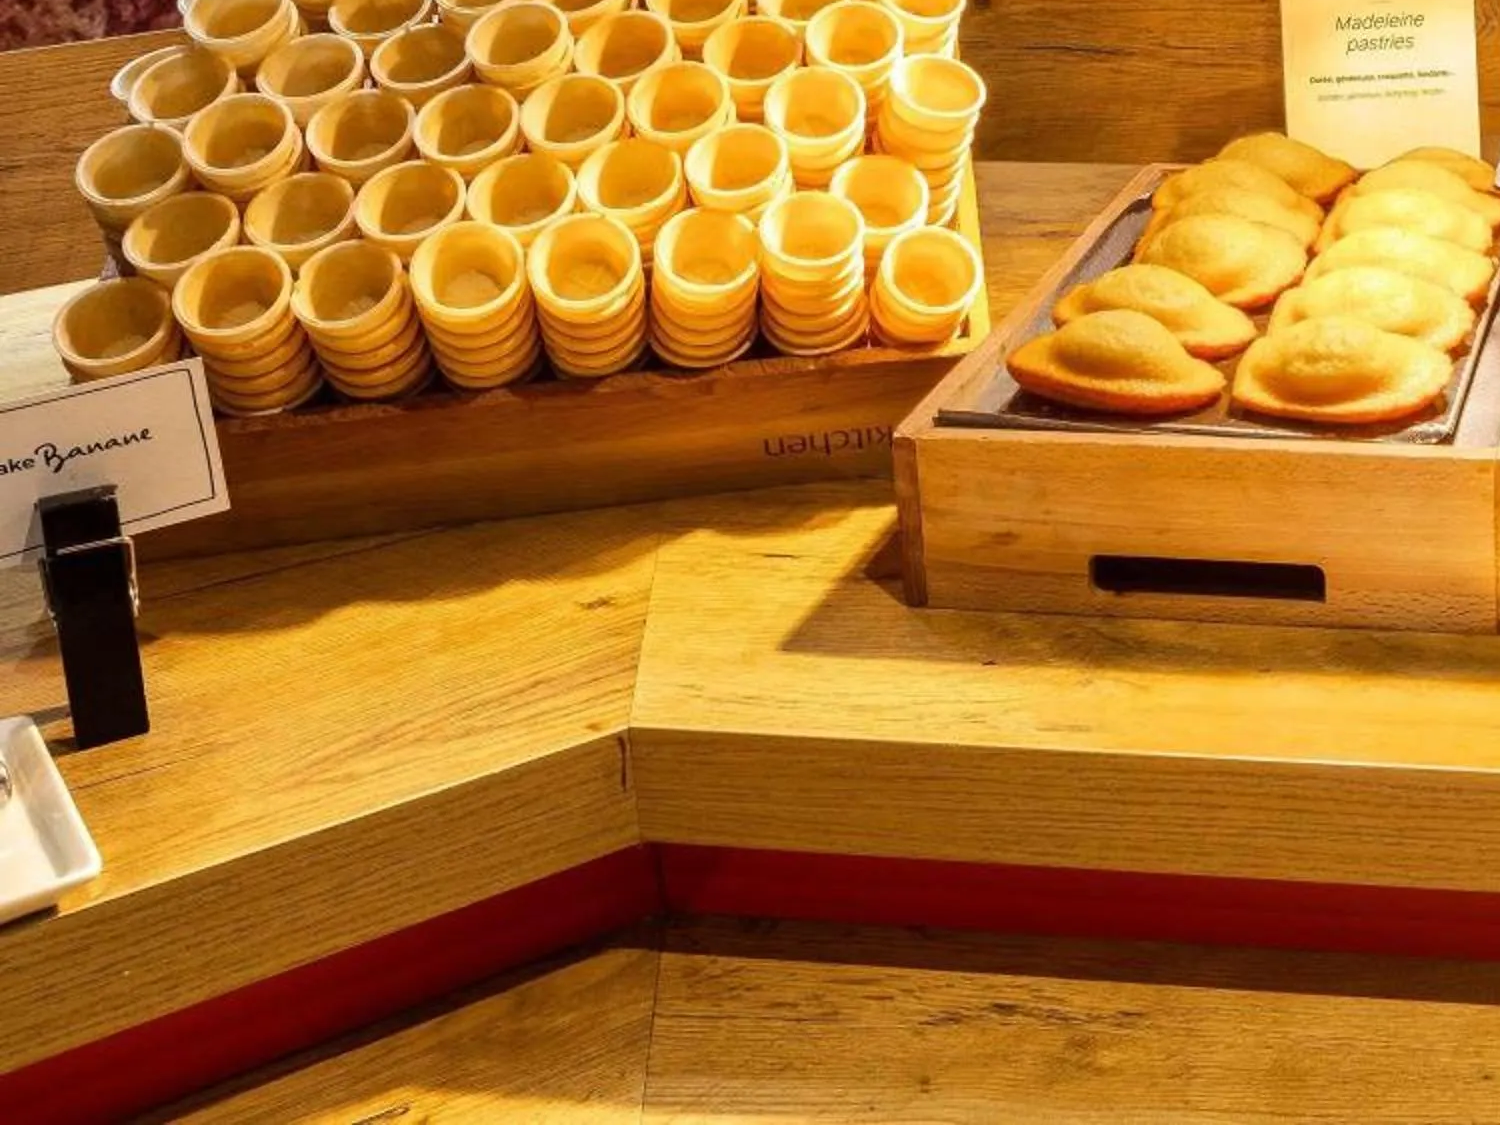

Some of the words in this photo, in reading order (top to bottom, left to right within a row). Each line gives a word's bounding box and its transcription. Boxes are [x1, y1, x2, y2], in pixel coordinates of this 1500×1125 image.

[1335, 11, 1425, 32] Madeleine
[1345, 34, 1416, 56] pastries
[0, 458, 35, 475] ake
[34, 428, 153, 474] Banane
[763, 425, 894, 458] kitchen
